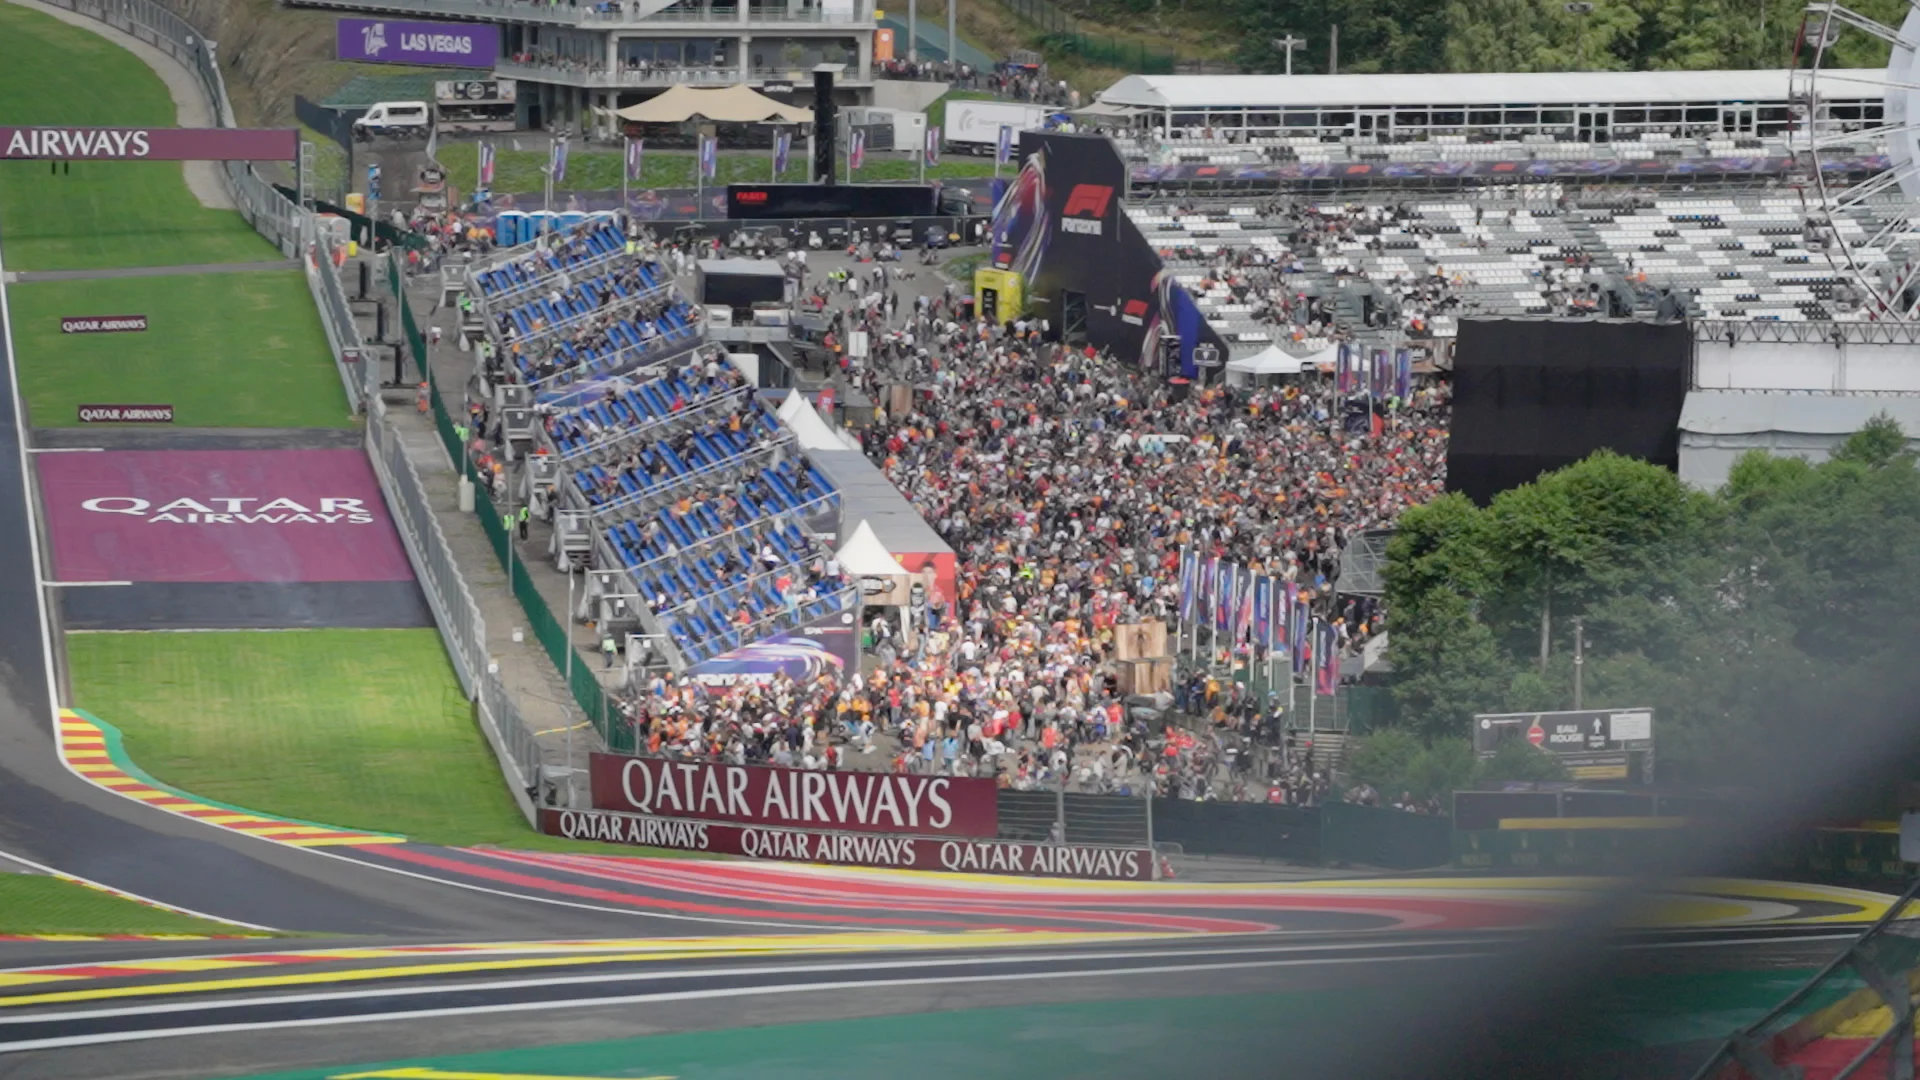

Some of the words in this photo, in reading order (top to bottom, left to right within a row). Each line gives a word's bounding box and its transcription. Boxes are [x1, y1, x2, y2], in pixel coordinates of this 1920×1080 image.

[400, 32, 427, 52] LAS
[427, 34, 473, 54] VEGAS
[5, 129, 150, 157] AIRWAYS
[62, 321, 100, 333] QATAR
[100, 319, 146, 330] AIRWAYS
[80, 408, 121, 422] QATAR
[121, 409, 173, 420] AIRWAYS
[81, 496, 370, 516] QATAR
[147, 512, 374, 524] AIRWAYS
[622, 759, 752, 817] QATAR
[762, 770, 952, 829] AIRWAYS
[560, 811, 623, 841] QATAR
[627, 818, 709, 849] AIRWAYS
[741, 828, 811, 858] QATAR
[815, 834, 916, 865] AIRWAYS
[940, 841, 1025, 871] QATAR
[1030, 846, 1139, 877] AIRWAYS
